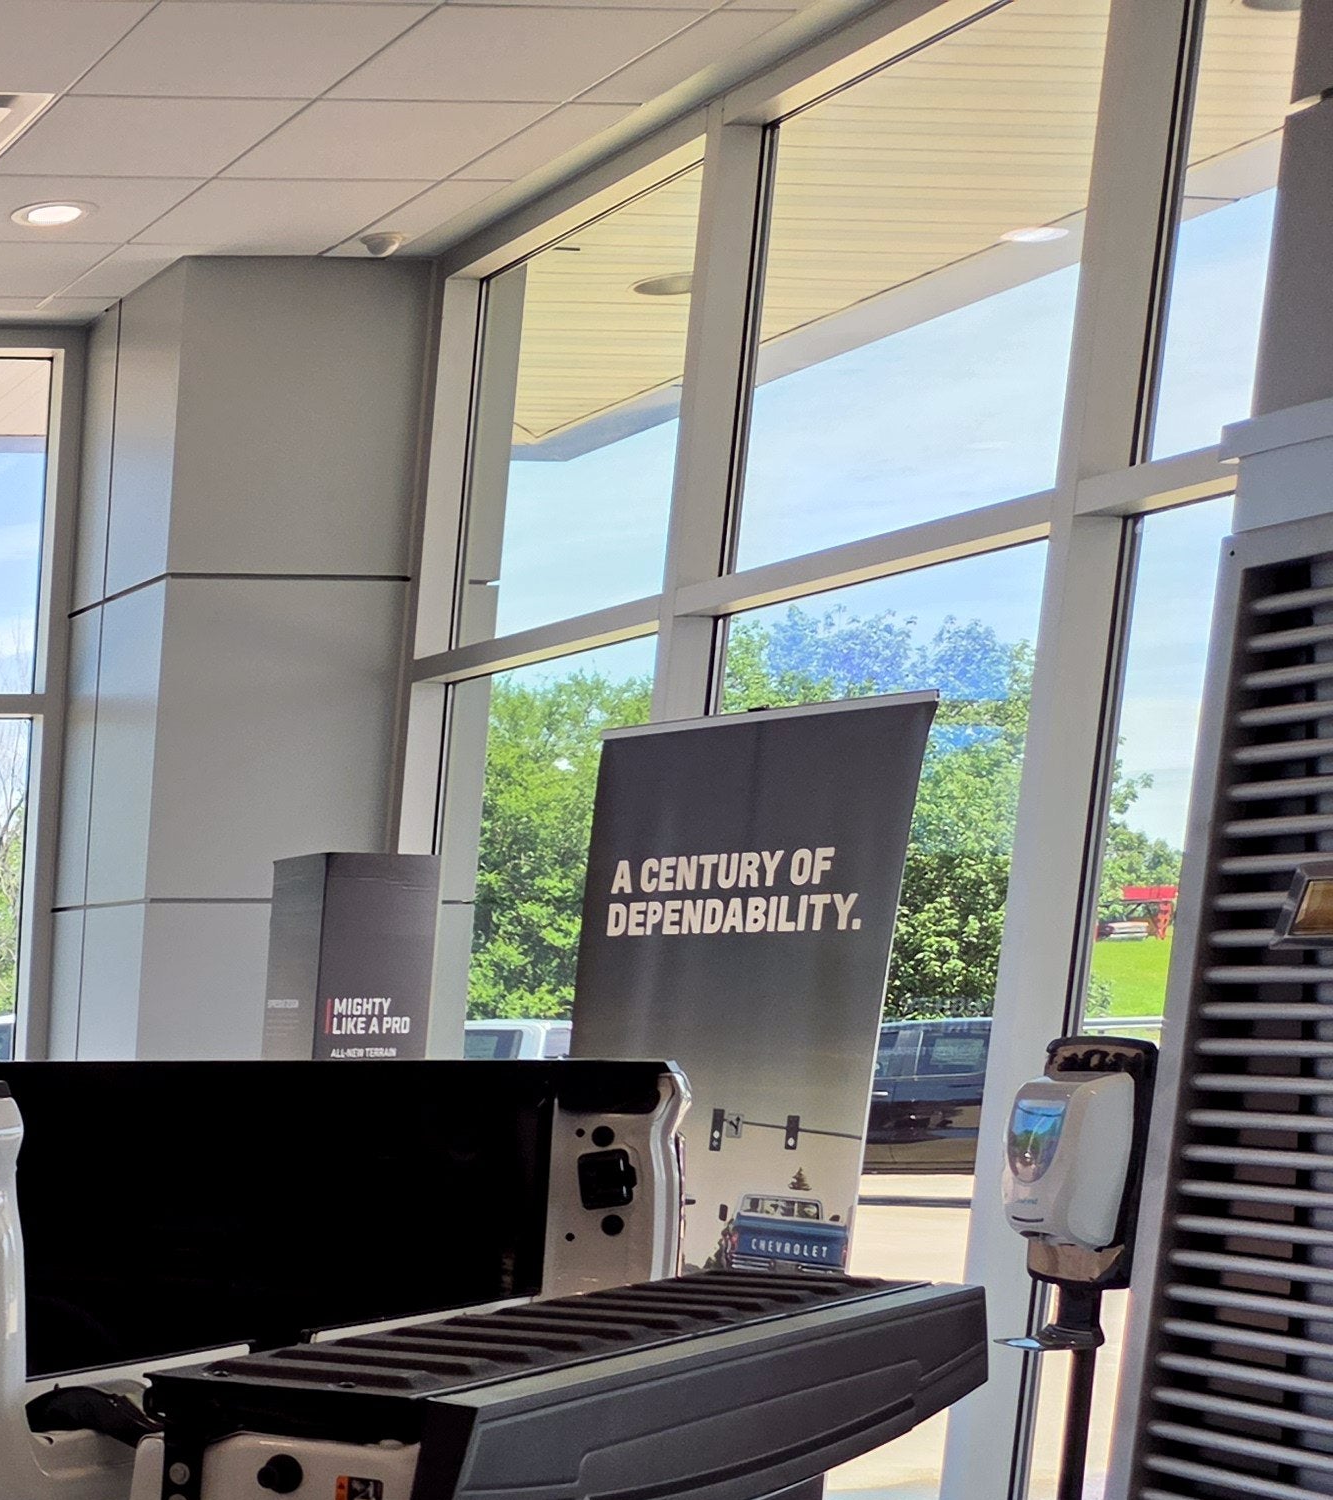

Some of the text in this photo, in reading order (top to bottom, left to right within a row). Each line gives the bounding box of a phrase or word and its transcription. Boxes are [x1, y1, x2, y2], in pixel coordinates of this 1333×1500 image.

[610, 847, 836, 894] A CENTURY OF
[606, 893, 862, 937] DEPENDABILITY.
[333, 997, 392, 1016] MIGHTY
[332, 1016, 411, 1035] LIKE A PRO
[330, 1047, 397, 1058] ALL-NEW TERRAIN
[751, 1238, 828, 1258] CHEVROLET
